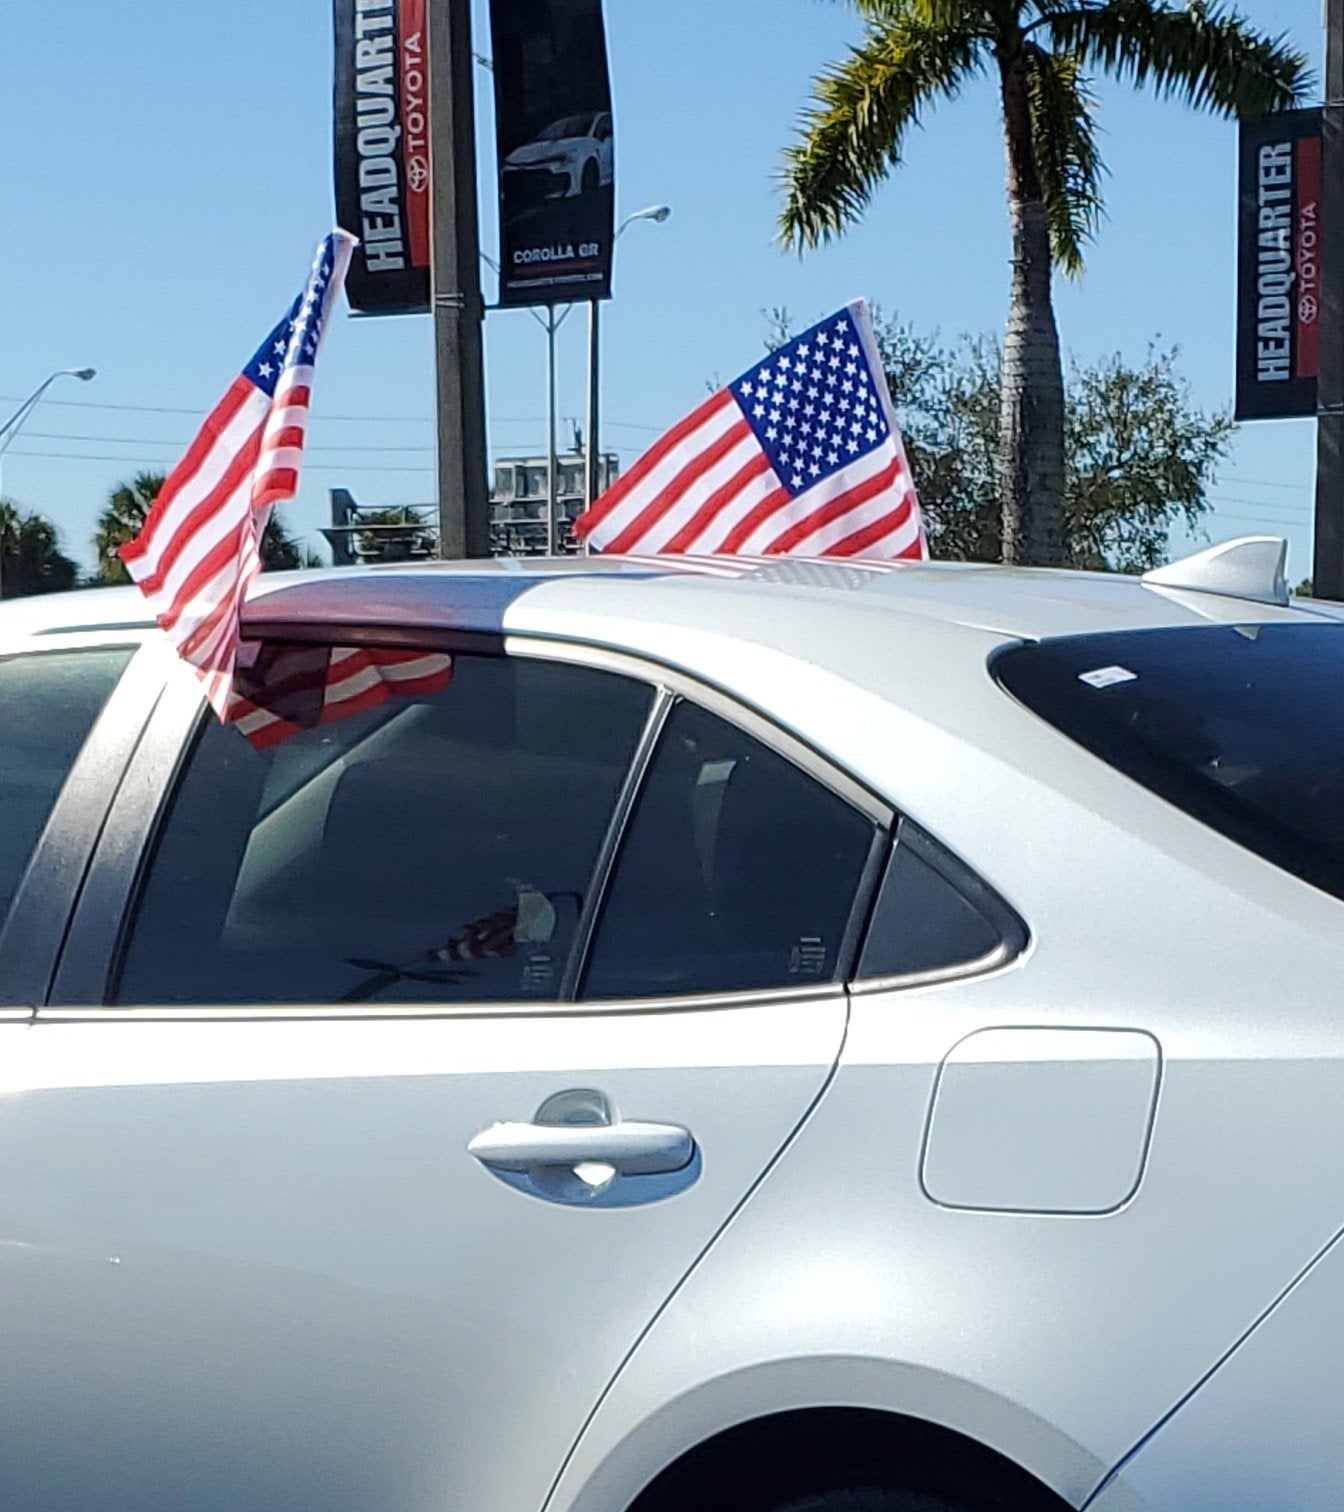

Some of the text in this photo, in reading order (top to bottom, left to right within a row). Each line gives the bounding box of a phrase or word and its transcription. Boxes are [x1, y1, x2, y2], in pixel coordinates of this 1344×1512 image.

[406, 31, 426, 153] TOYOTA
[513, 243, 575, 264] COROLLA
[1257, 141, 1295, 382] HEADQUARTER
[1299, 201, 1318, 292] TOYOTA
